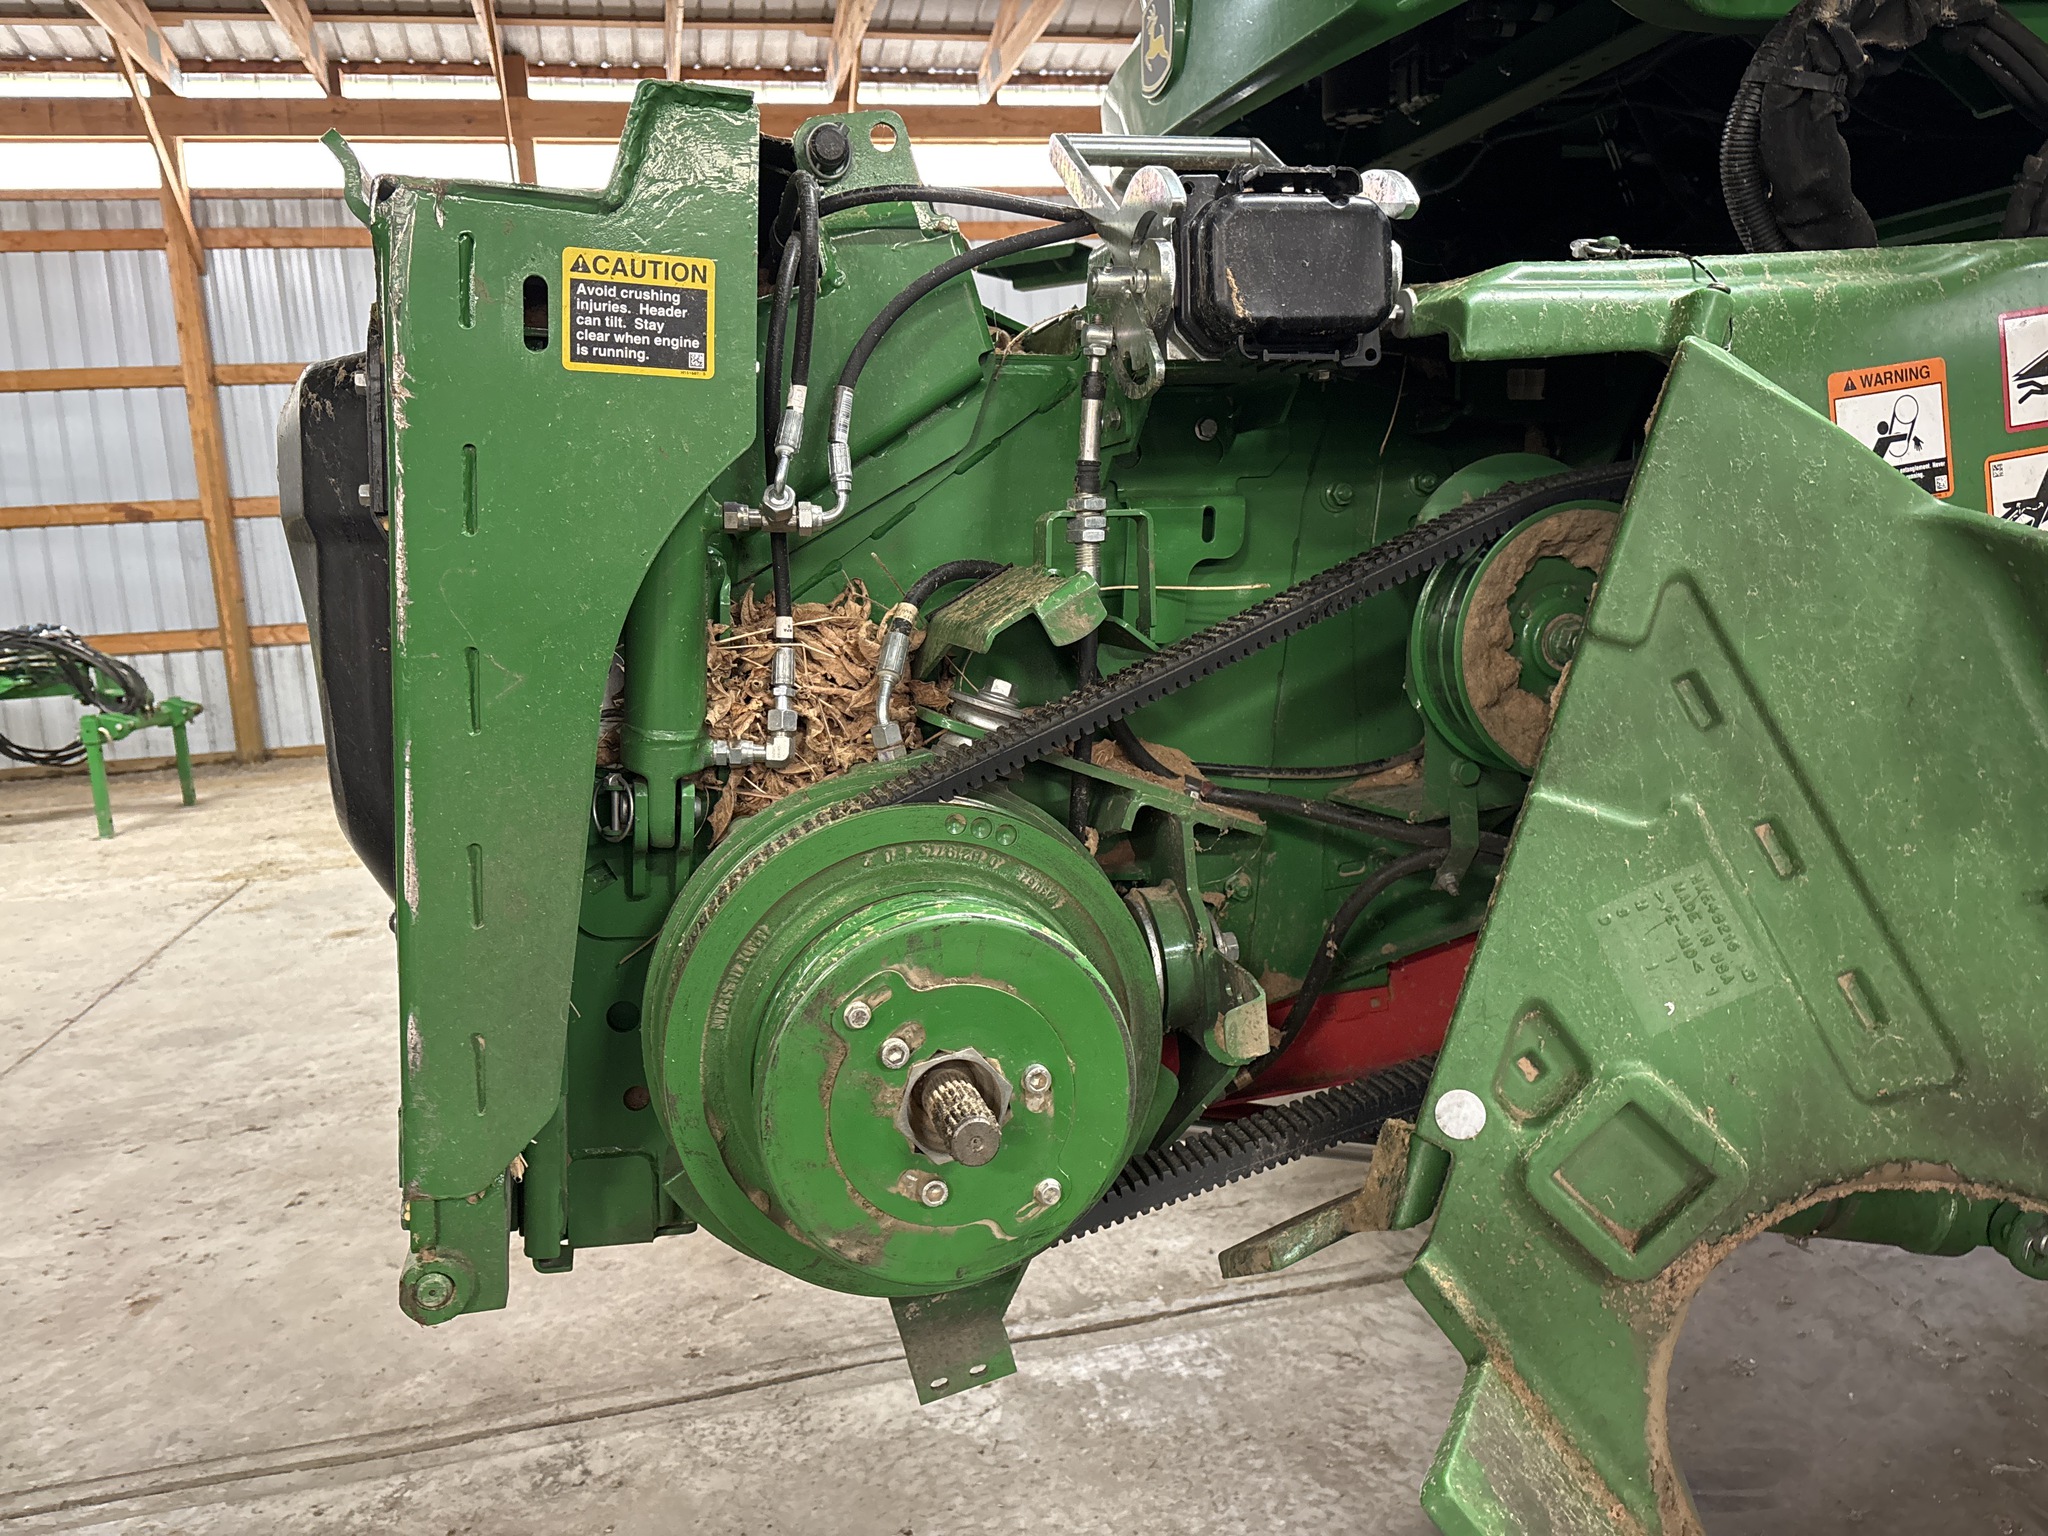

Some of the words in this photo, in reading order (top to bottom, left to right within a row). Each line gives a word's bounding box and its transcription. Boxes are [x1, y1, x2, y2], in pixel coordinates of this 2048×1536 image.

[592, 255, 707, 284] CAUTION
[576, 283, 617, 298] Avoid
[620, 288, 681, 305] crushing
[576, 298, 631, 314] injuries.
[639, 303, 688, 318] Header
[576, 315, 601, 327] can
[605, 315, 627, 329] tilt.
[634, 317, 665, 334] Stay
[576, 329, 610, 342] clear
[613, 332, 650, 346] when
[653, 336, 700, 350] engine
[576, 343, 589, 356] is
[592, 346, 650, 363] running.
[1860, 365, 1931, 389] WARNING
[1671, 881, 1703, 924] MADE
[1696, 928, 1716, 948] IN
[1710, 952, 1735, 985] USA
